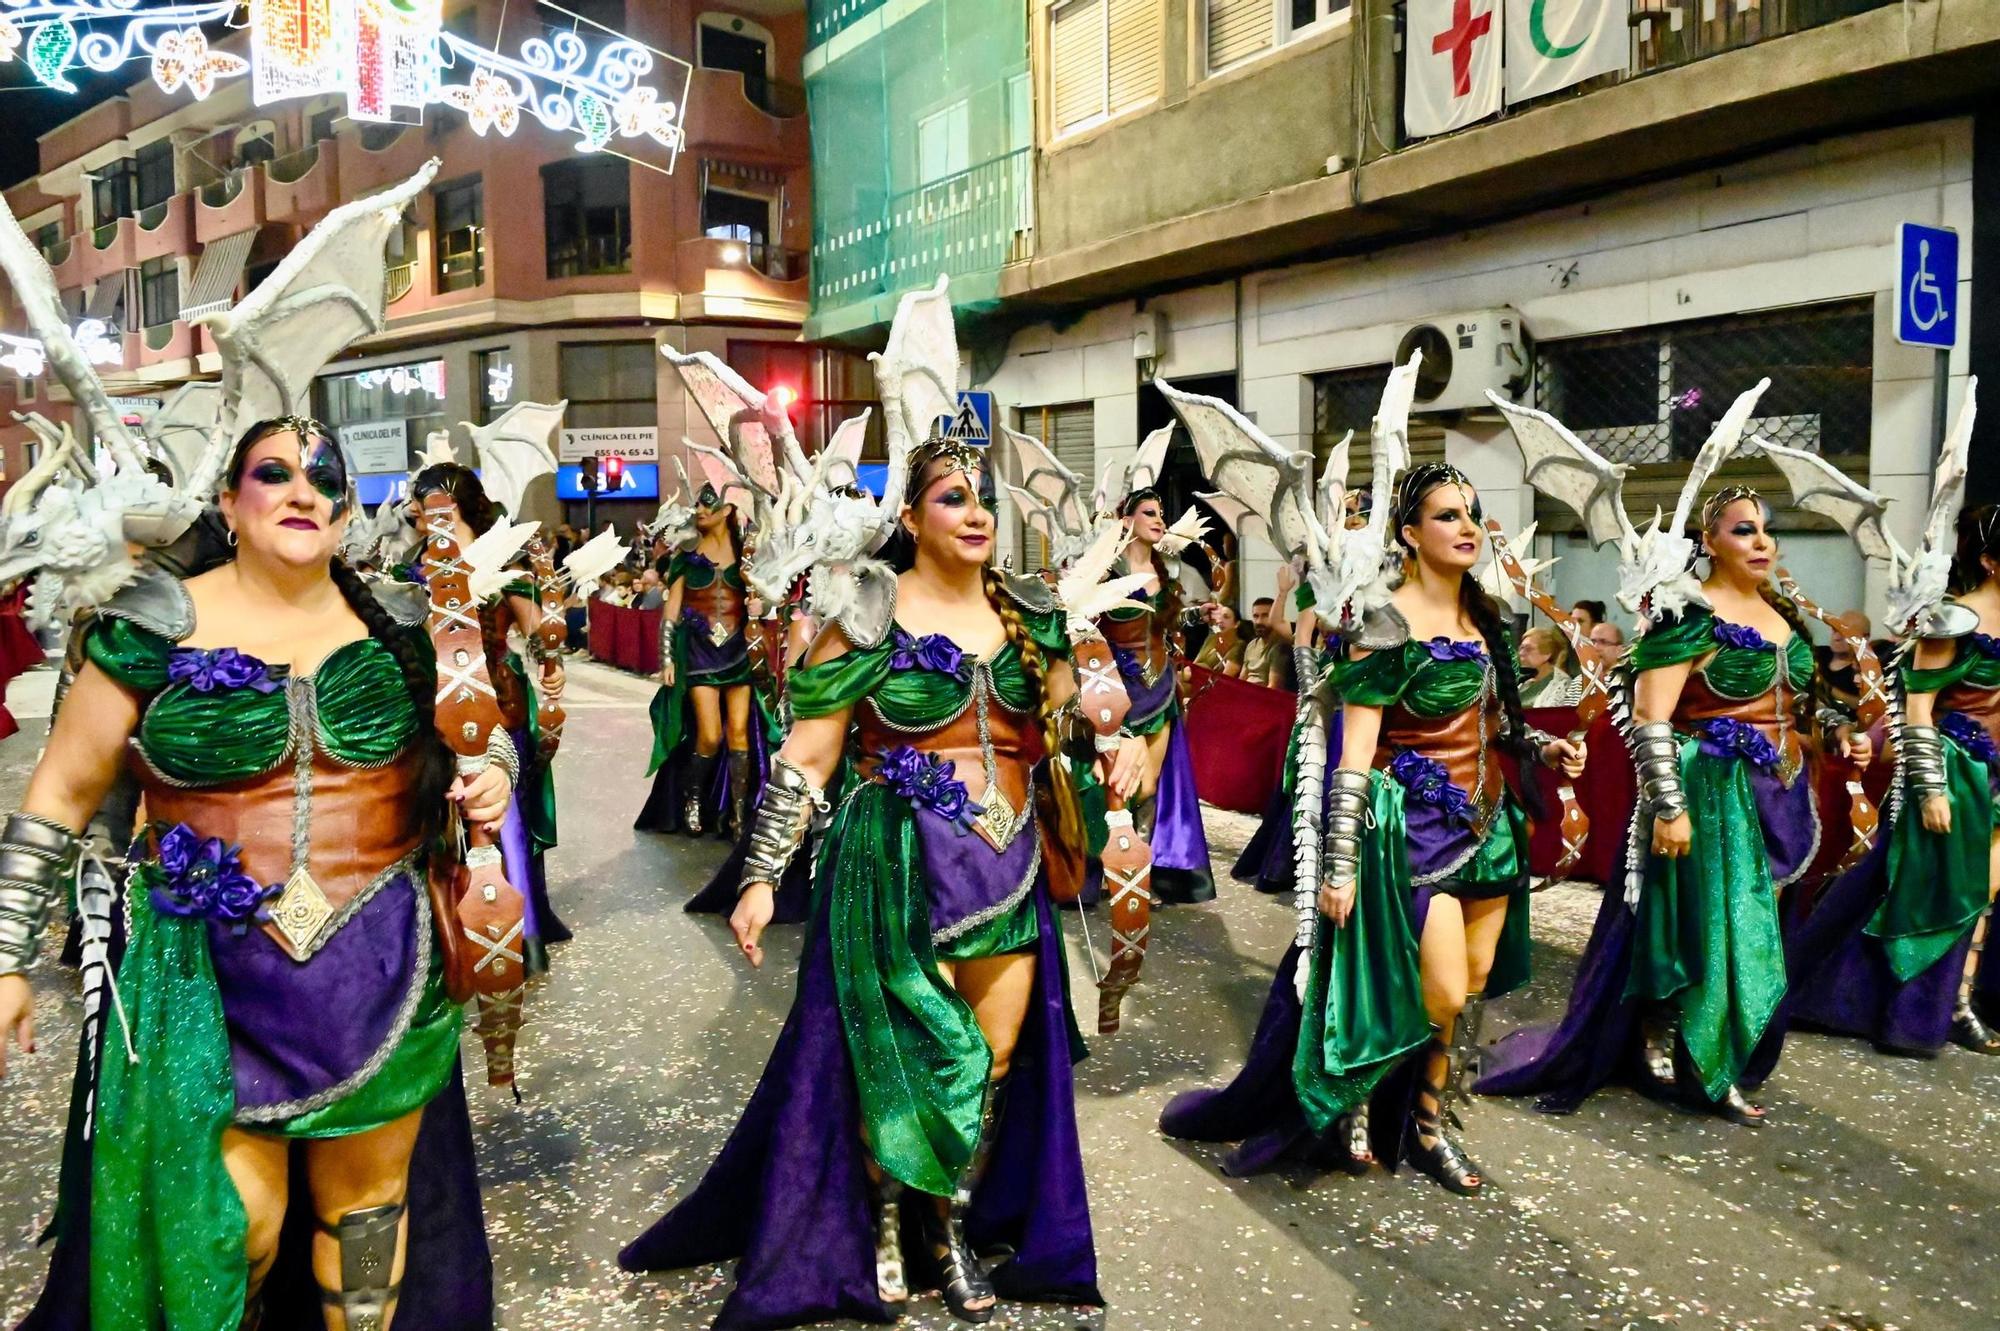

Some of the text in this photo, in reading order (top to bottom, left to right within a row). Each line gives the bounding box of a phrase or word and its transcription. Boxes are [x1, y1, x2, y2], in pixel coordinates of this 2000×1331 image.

[1467, 323, 1477, 332] LG
[379, 429, 390, 439] DEL
[391, 427, 401, 437] PIE
[640, 432, 654, 440] PIE
[594, 449, 611, 457] 655
[628, 448, 640, 456] 65
[643, 448, 654, 456] 43
